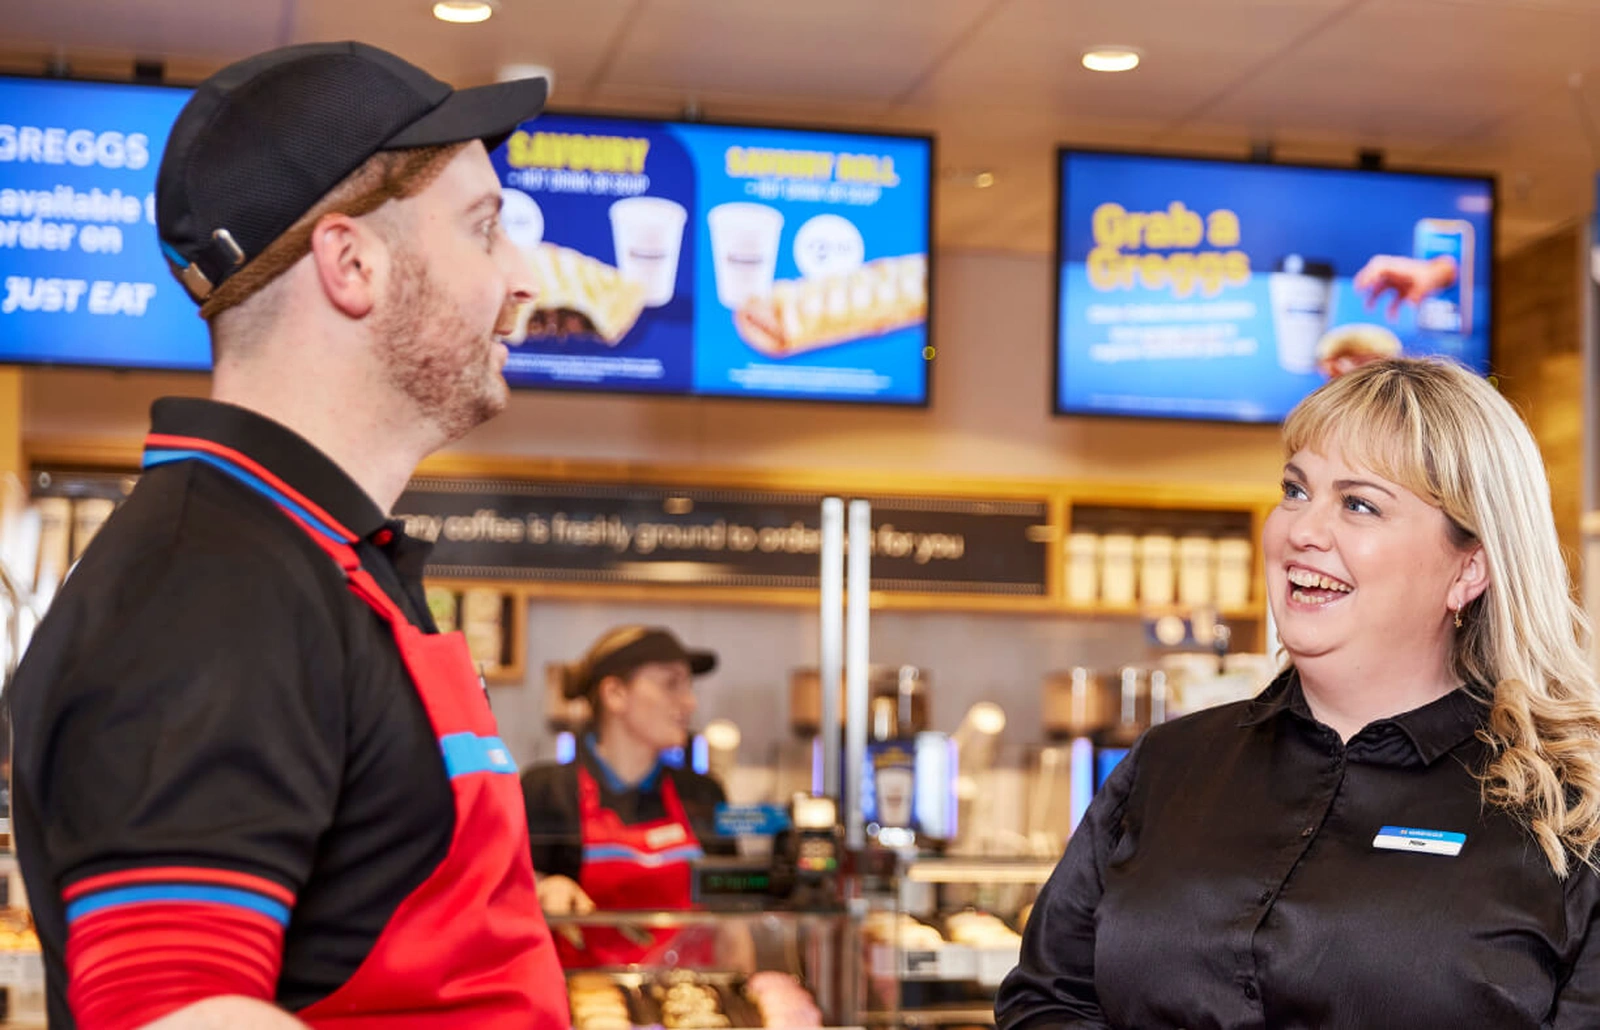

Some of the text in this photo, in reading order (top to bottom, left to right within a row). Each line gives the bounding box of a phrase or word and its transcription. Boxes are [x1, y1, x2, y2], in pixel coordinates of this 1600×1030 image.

[507, 131, 650, 175] SAVOURY
[0, 184, 141, 224] available
[1092, 202, 1240, 249] Grab a
[79, 224, 122, 254] on
[1086, 245, 1252, 298] Greggs
[2, 276, 157, 317] JUST EAT
[443, 508, 525, 543] coffee
[527, 512, 549, 544] is
[552, 511, 632, 552] freshly
[634, 518, 727, 554] ground
[728, 522, 758, 553] to
[877, 523, 914, 557] for
[914, 532, 965, 564] you
